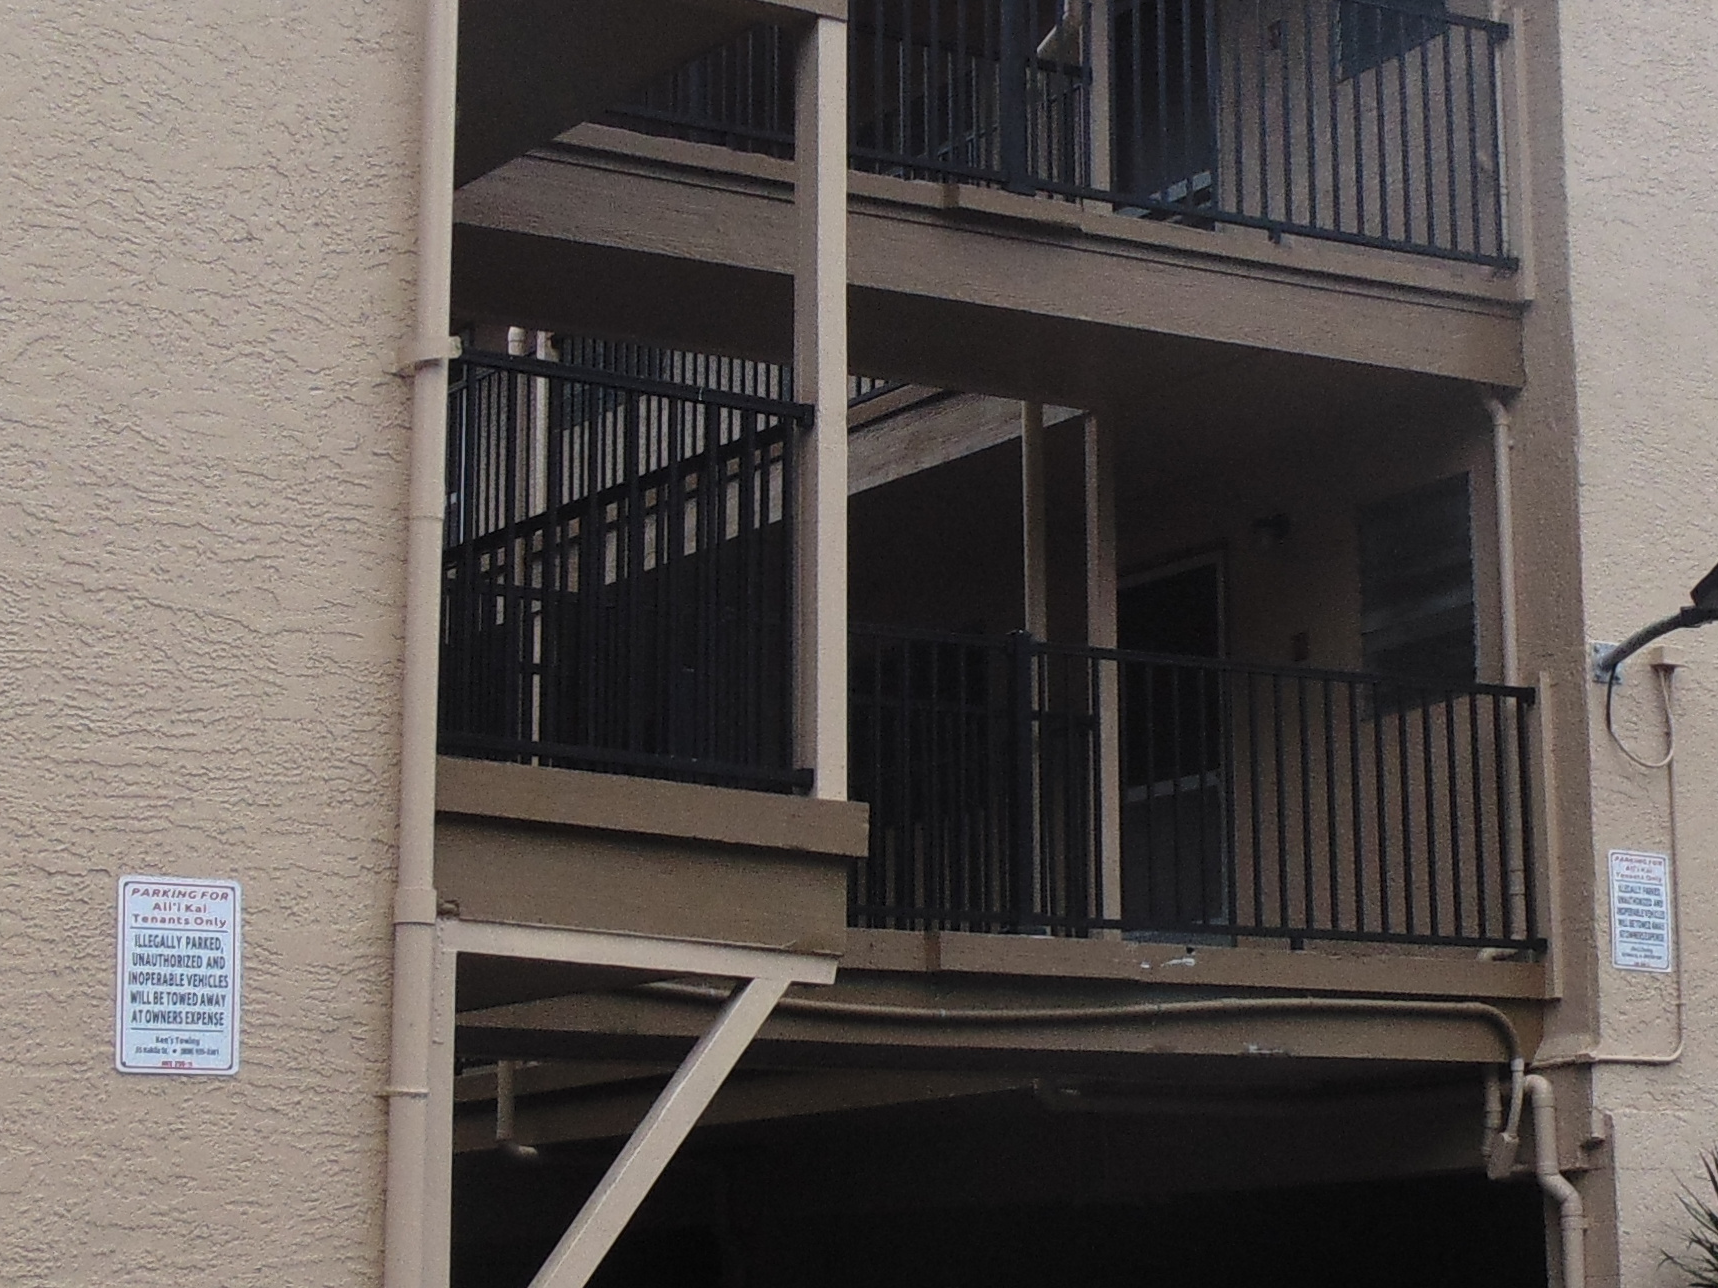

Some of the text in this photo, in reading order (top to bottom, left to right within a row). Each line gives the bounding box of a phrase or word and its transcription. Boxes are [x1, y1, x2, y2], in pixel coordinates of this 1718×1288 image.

[131, 888, 229, 901] PARKING FOR
[185, 904, 207, 913] Kai
[132, 914, 227, 928] Tenants Only
[134, 934, 224, 954] ILLEGALLY PARKED,
[132, 952, 226, 970] UNAUTHORIZED AND
[128, 971, 229, 988] INOPERABLE VEHICLES
[130, 990, 226, 1007] WILL BE TOWED AWAY
[131, 1009, 224, 1026] AT OWNERS EXPENSE
[175, 1036, 200, 1046] Towing
